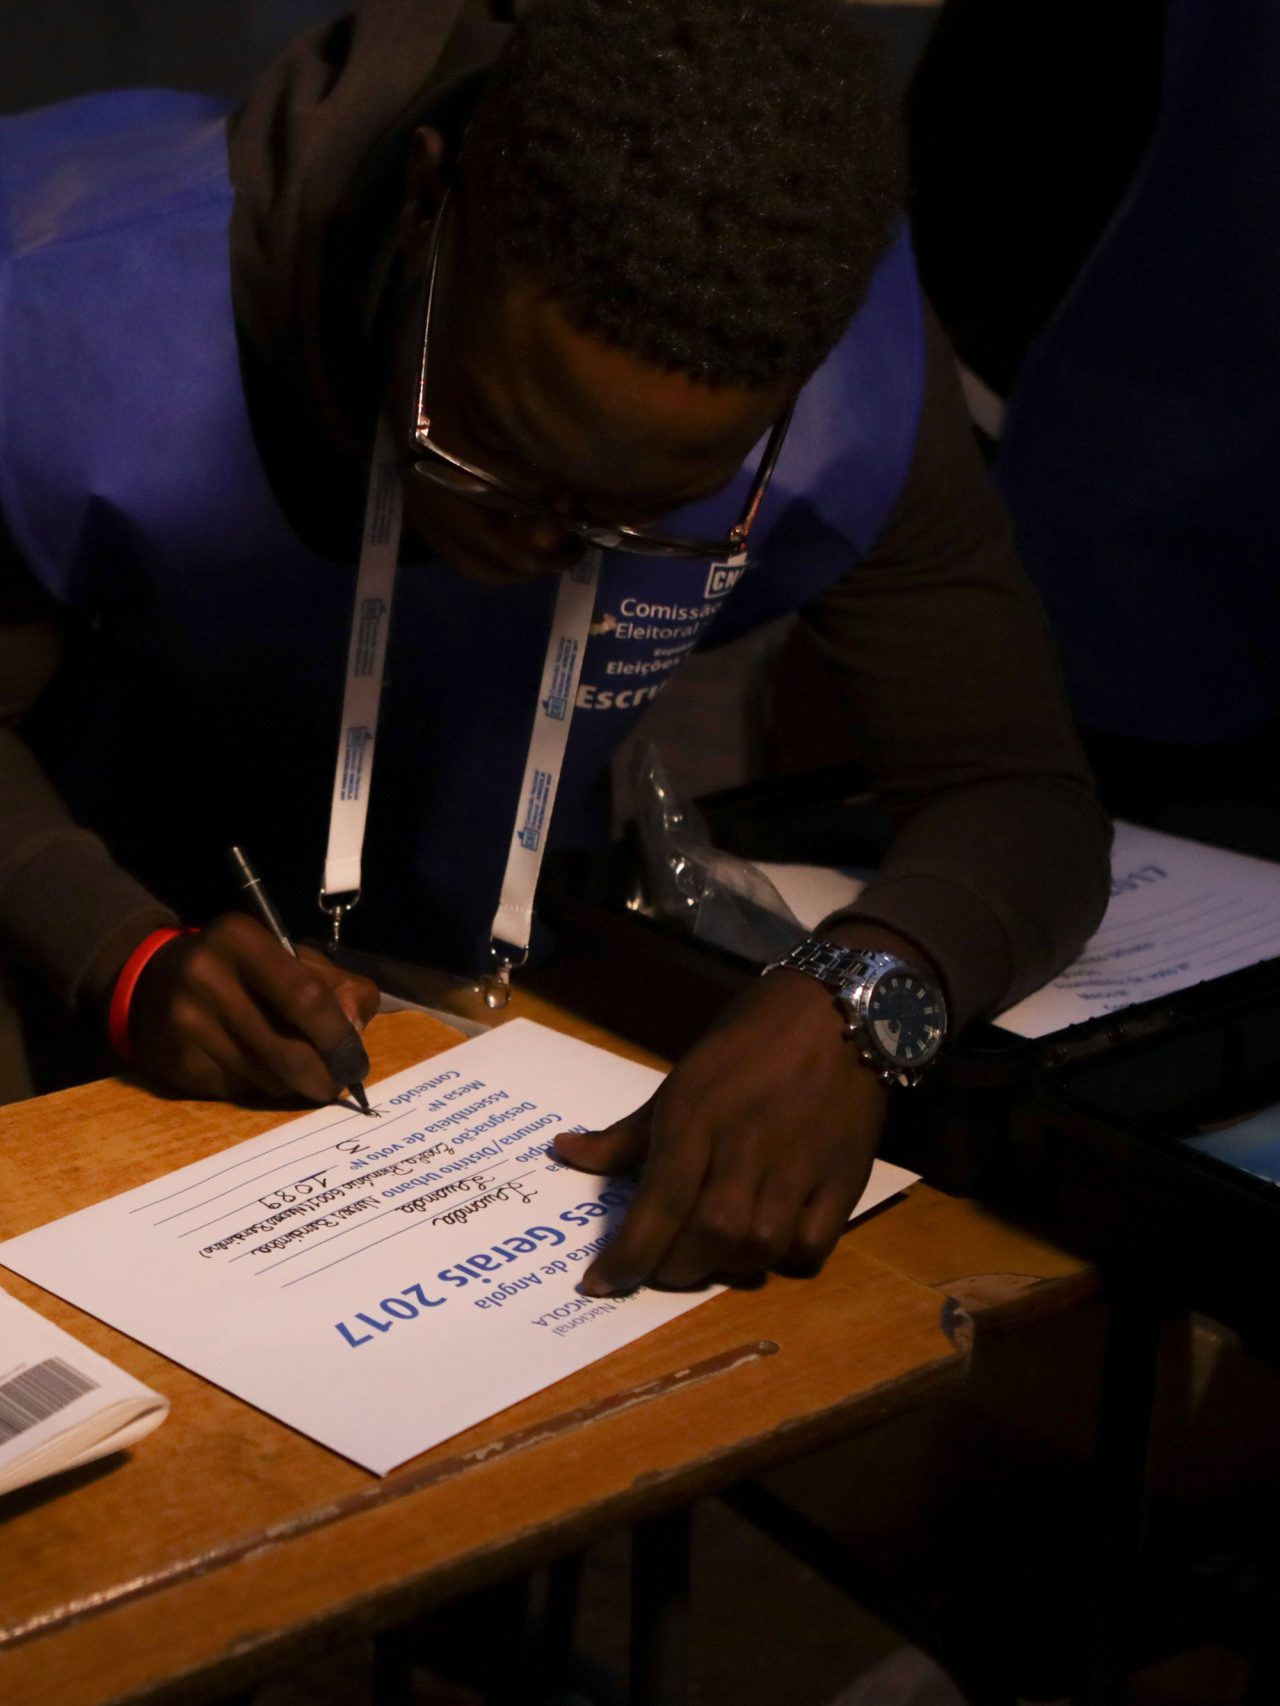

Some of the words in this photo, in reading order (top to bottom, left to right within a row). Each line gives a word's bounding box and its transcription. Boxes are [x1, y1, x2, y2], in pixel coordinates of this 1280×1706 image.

[390, 1069, 459, 1104] Conteúdo
[442, 1079, 485, 1103] Mesa
[423, 1089, 507, 1134] Assembleia
[451, 1099, 537, 1145] Designação
[335, 1140, 369, 1154] 3
[367, 1142, 402, 1161] voto
[404, 1129, 423, 1143] de
[439, 1112, 560, 1174] Comuna/Distrito
[257, 1171, 326, 1211] 1089
[382, 1171, 441, 1198] Urbano
[437, 1227, 565, 1286] Gerais
[543, 1258, 567, 1275] de
[475, 1271, 542, 1309] Angola
[334, 1282, 446, 1348] 2017
[530, 1298, 592, 1325] NGOLA
[551, 1304, 615, 1337] Nacional
